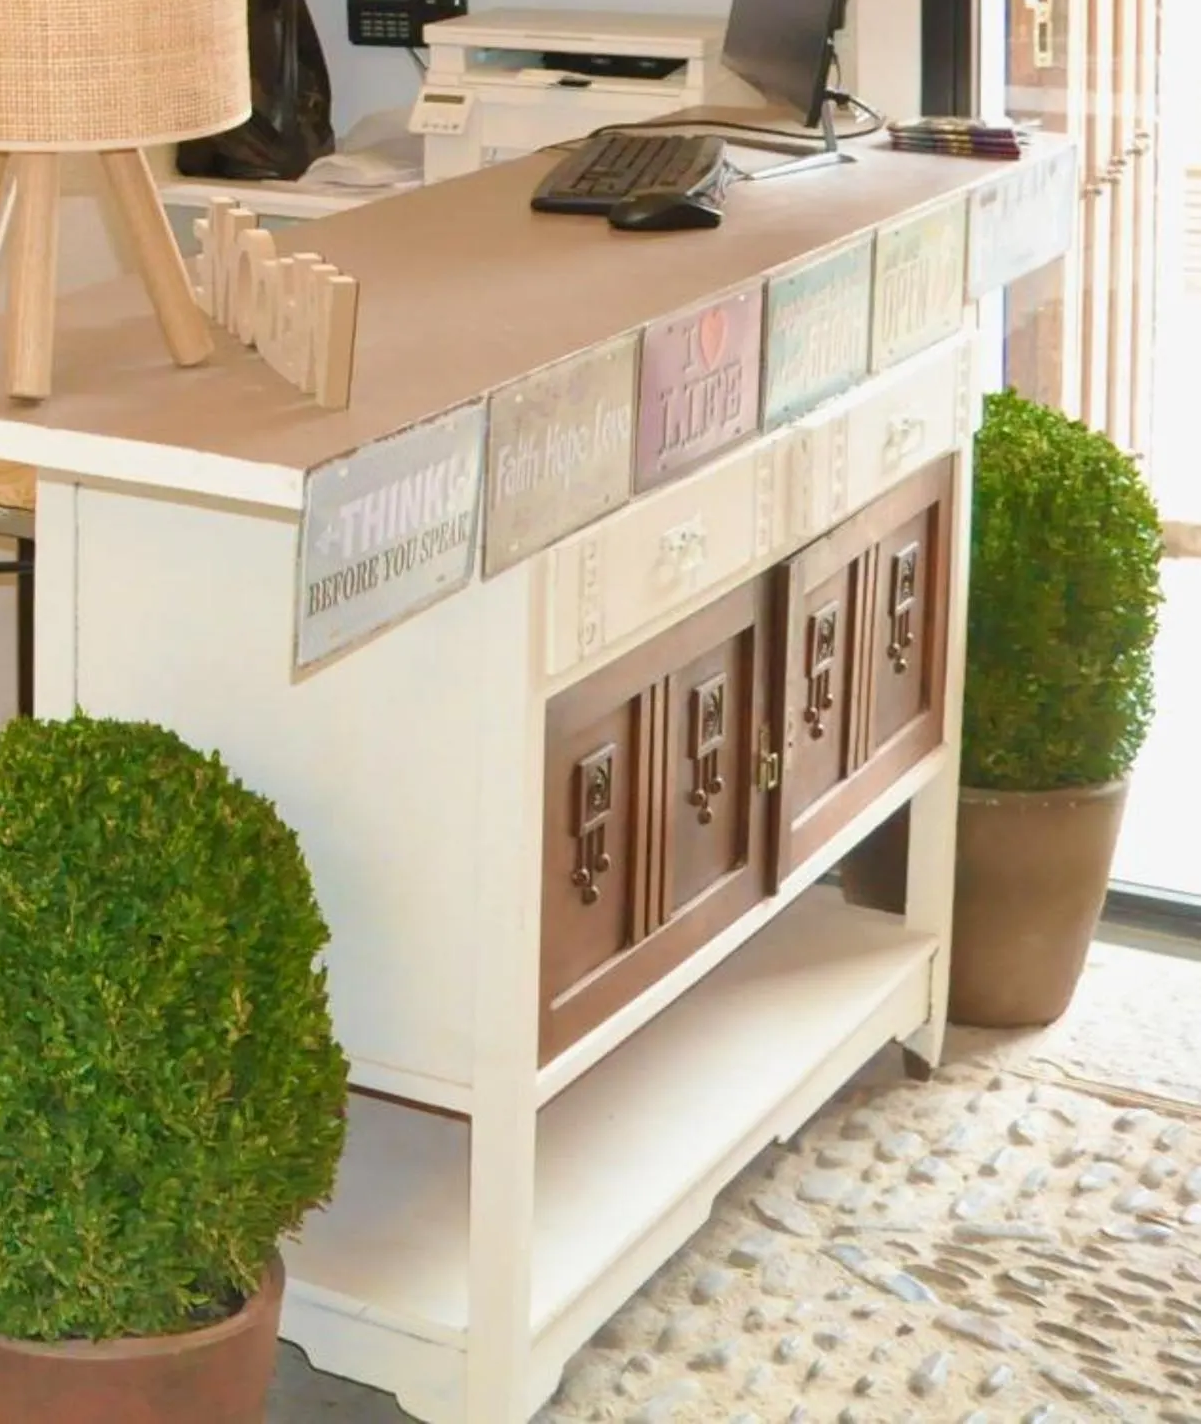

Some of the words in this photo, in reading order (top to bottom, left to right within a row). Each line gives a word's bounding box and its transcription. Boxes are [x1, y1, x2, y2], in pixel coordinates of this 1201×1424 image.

[682, 324, 698, 372] I
[658, 361, 744, 459] LIFE
[495, 431, 539, 501] Faith
[543, 422, 591, 490] Hope
[307, 557, 380, 618] BEFORE
[382, 537, 418, 581] YOU
[419, 510, 471, 564] SPEAK
